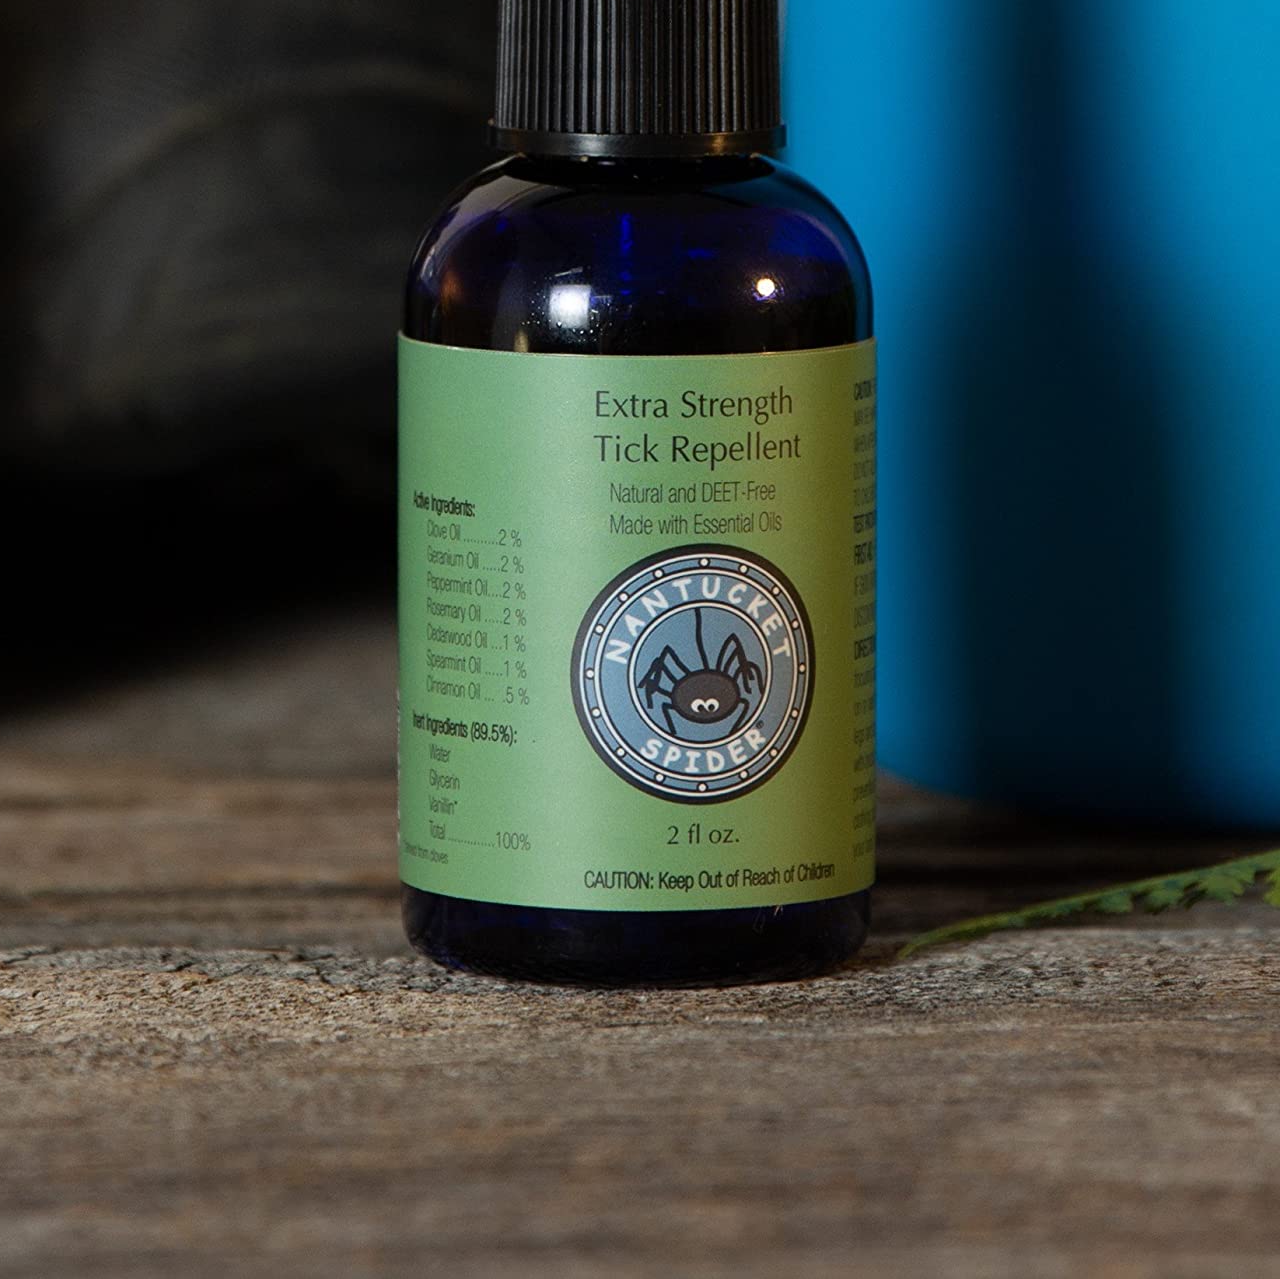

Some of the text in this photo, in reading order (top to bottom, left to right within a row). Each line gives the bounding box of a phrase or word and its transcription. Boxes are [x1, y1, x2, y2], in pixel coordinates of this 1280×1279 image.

[596, 385, 793, 426] Extra Strength
[593, 431, 801, 471] Tick Repellent
[610, 480, 777, 504] Natural and DEET-Free
[449, 523, 461, 541] Oil
[610, 511, 783, 536] Made with Essential Oils
[426, 545, 464, 568] Geranium
[466, 552, 480, 570] Oil
[426, 571, 472, 596] Peppermint
[474, 578, 488, 596] Oil
[426, 597, 467, 624] Rosemary
[468, 604, 481, 622] Oil
[605, 575, 791, 664] NANTUCKET
[426, 623, 472, 648] Cedarwood
[474, 630, 488, 649] Oil
[426, 649, 466, 674] Spearmint
[468, 656, 481, 674] Oil
[468, 681, 481, 700] Oil
[471, 721, 518, 747] (89.5%):
[429, 743, 451, 763] Water
[640, 726, 767, 773] SPIDER
[429, 769, 460, 791] Glycerin
[667, 823, 740, 845] 2 fl oz.
[584, 862, 836, 893] CAUTION: Keep Out of Reach of Children
